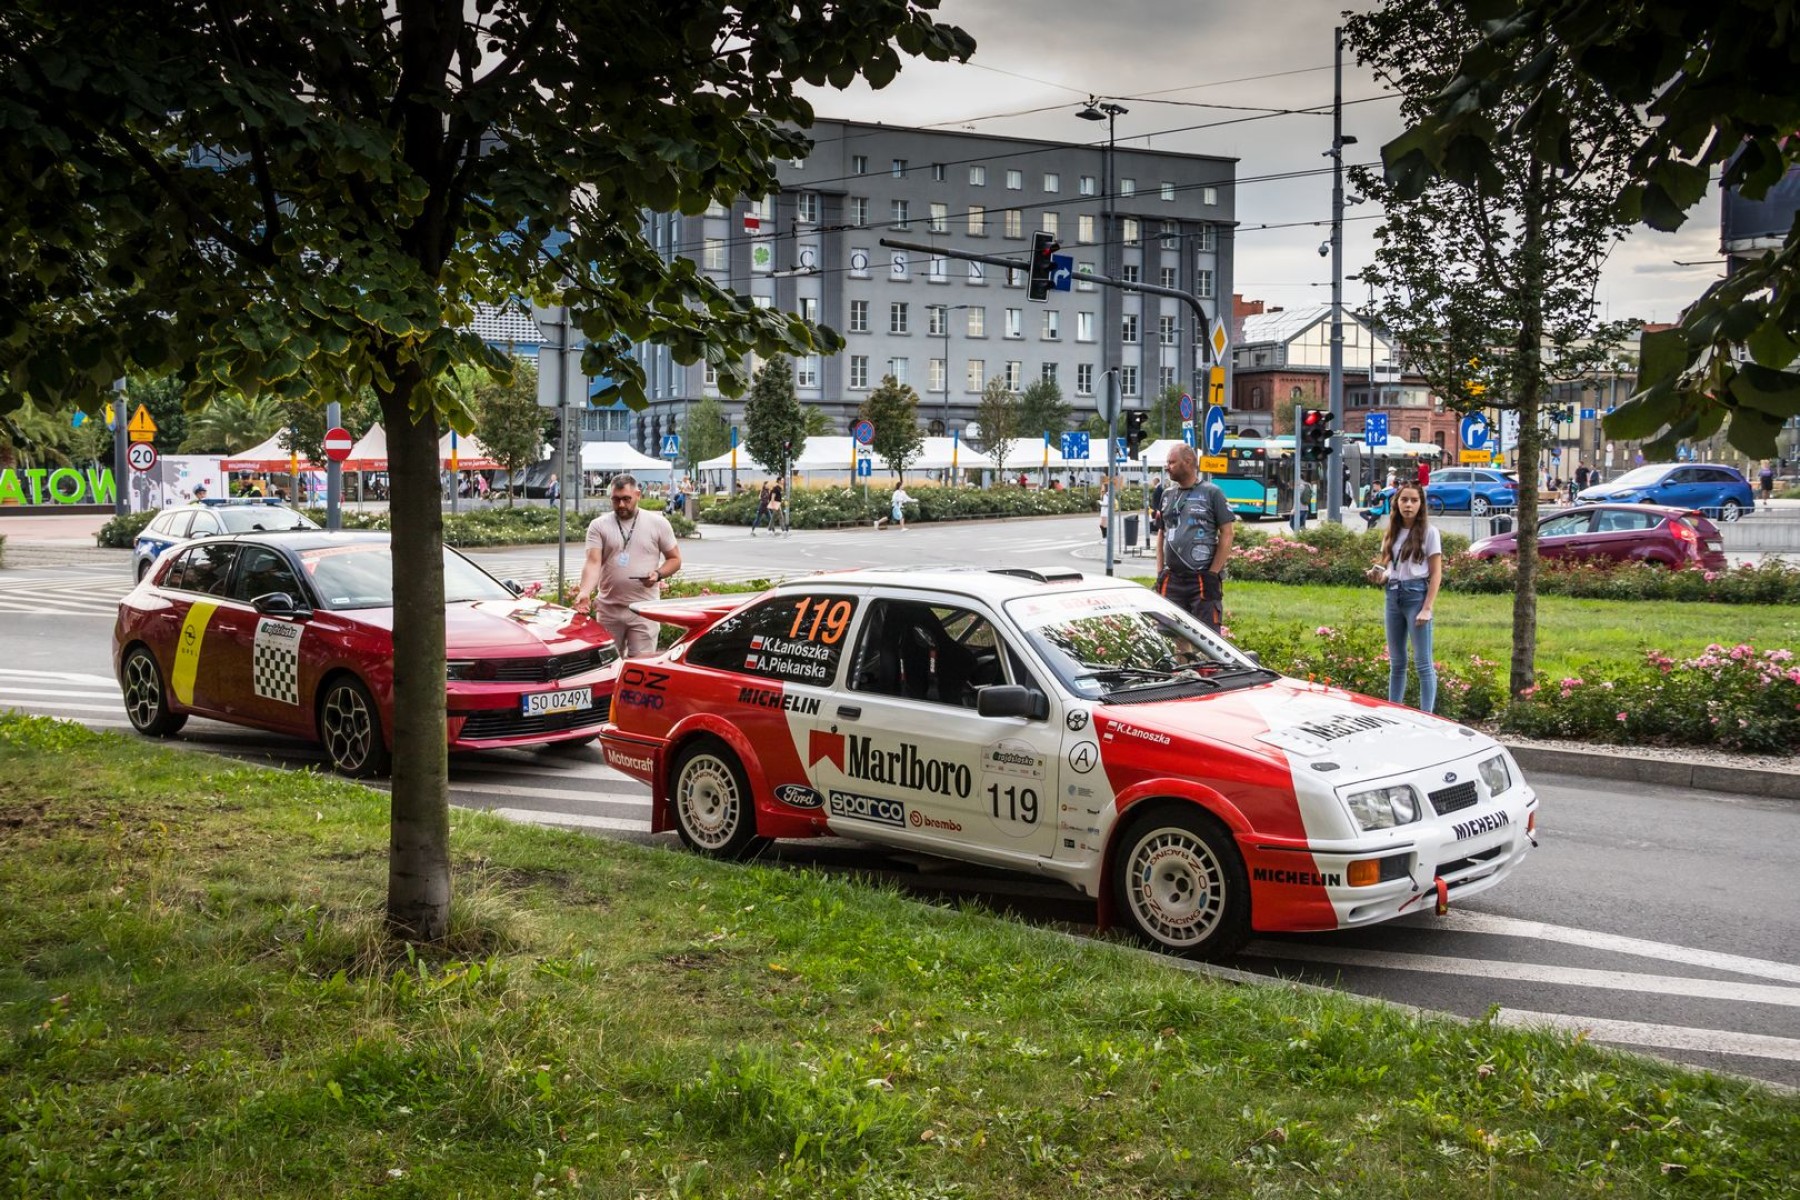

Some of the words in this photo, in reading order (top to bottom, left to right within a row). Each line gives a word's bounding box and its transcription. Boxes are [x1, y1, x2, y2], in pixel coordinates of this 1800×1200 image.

[132, 449, 153, 463] 20
[789, 597, 852, 645] 119
[762, 637, 829, 661] K.Łanoszka
[757, 656, 827, 678] A.Piekarska
[531, 695, 549, 711] SO
[552, 690, 589, 708] 0249X
[738, 687, 821, 715] MICHELIN
[607, 749, 654, 772] Motorcraft
[848, 734, 972, 799] Marlboro
[1074, 747, 1089, 768] A
[782, 785, 816, 806] Ford
[831, 792, 902, 822] sparco
[987, 783, 1038, 825] 119
[923, 815, 962, 832] brembo
[1451, 810, 1510, 841] MICHELIN
[1253, 867, 1341, 887] MICHELIN
